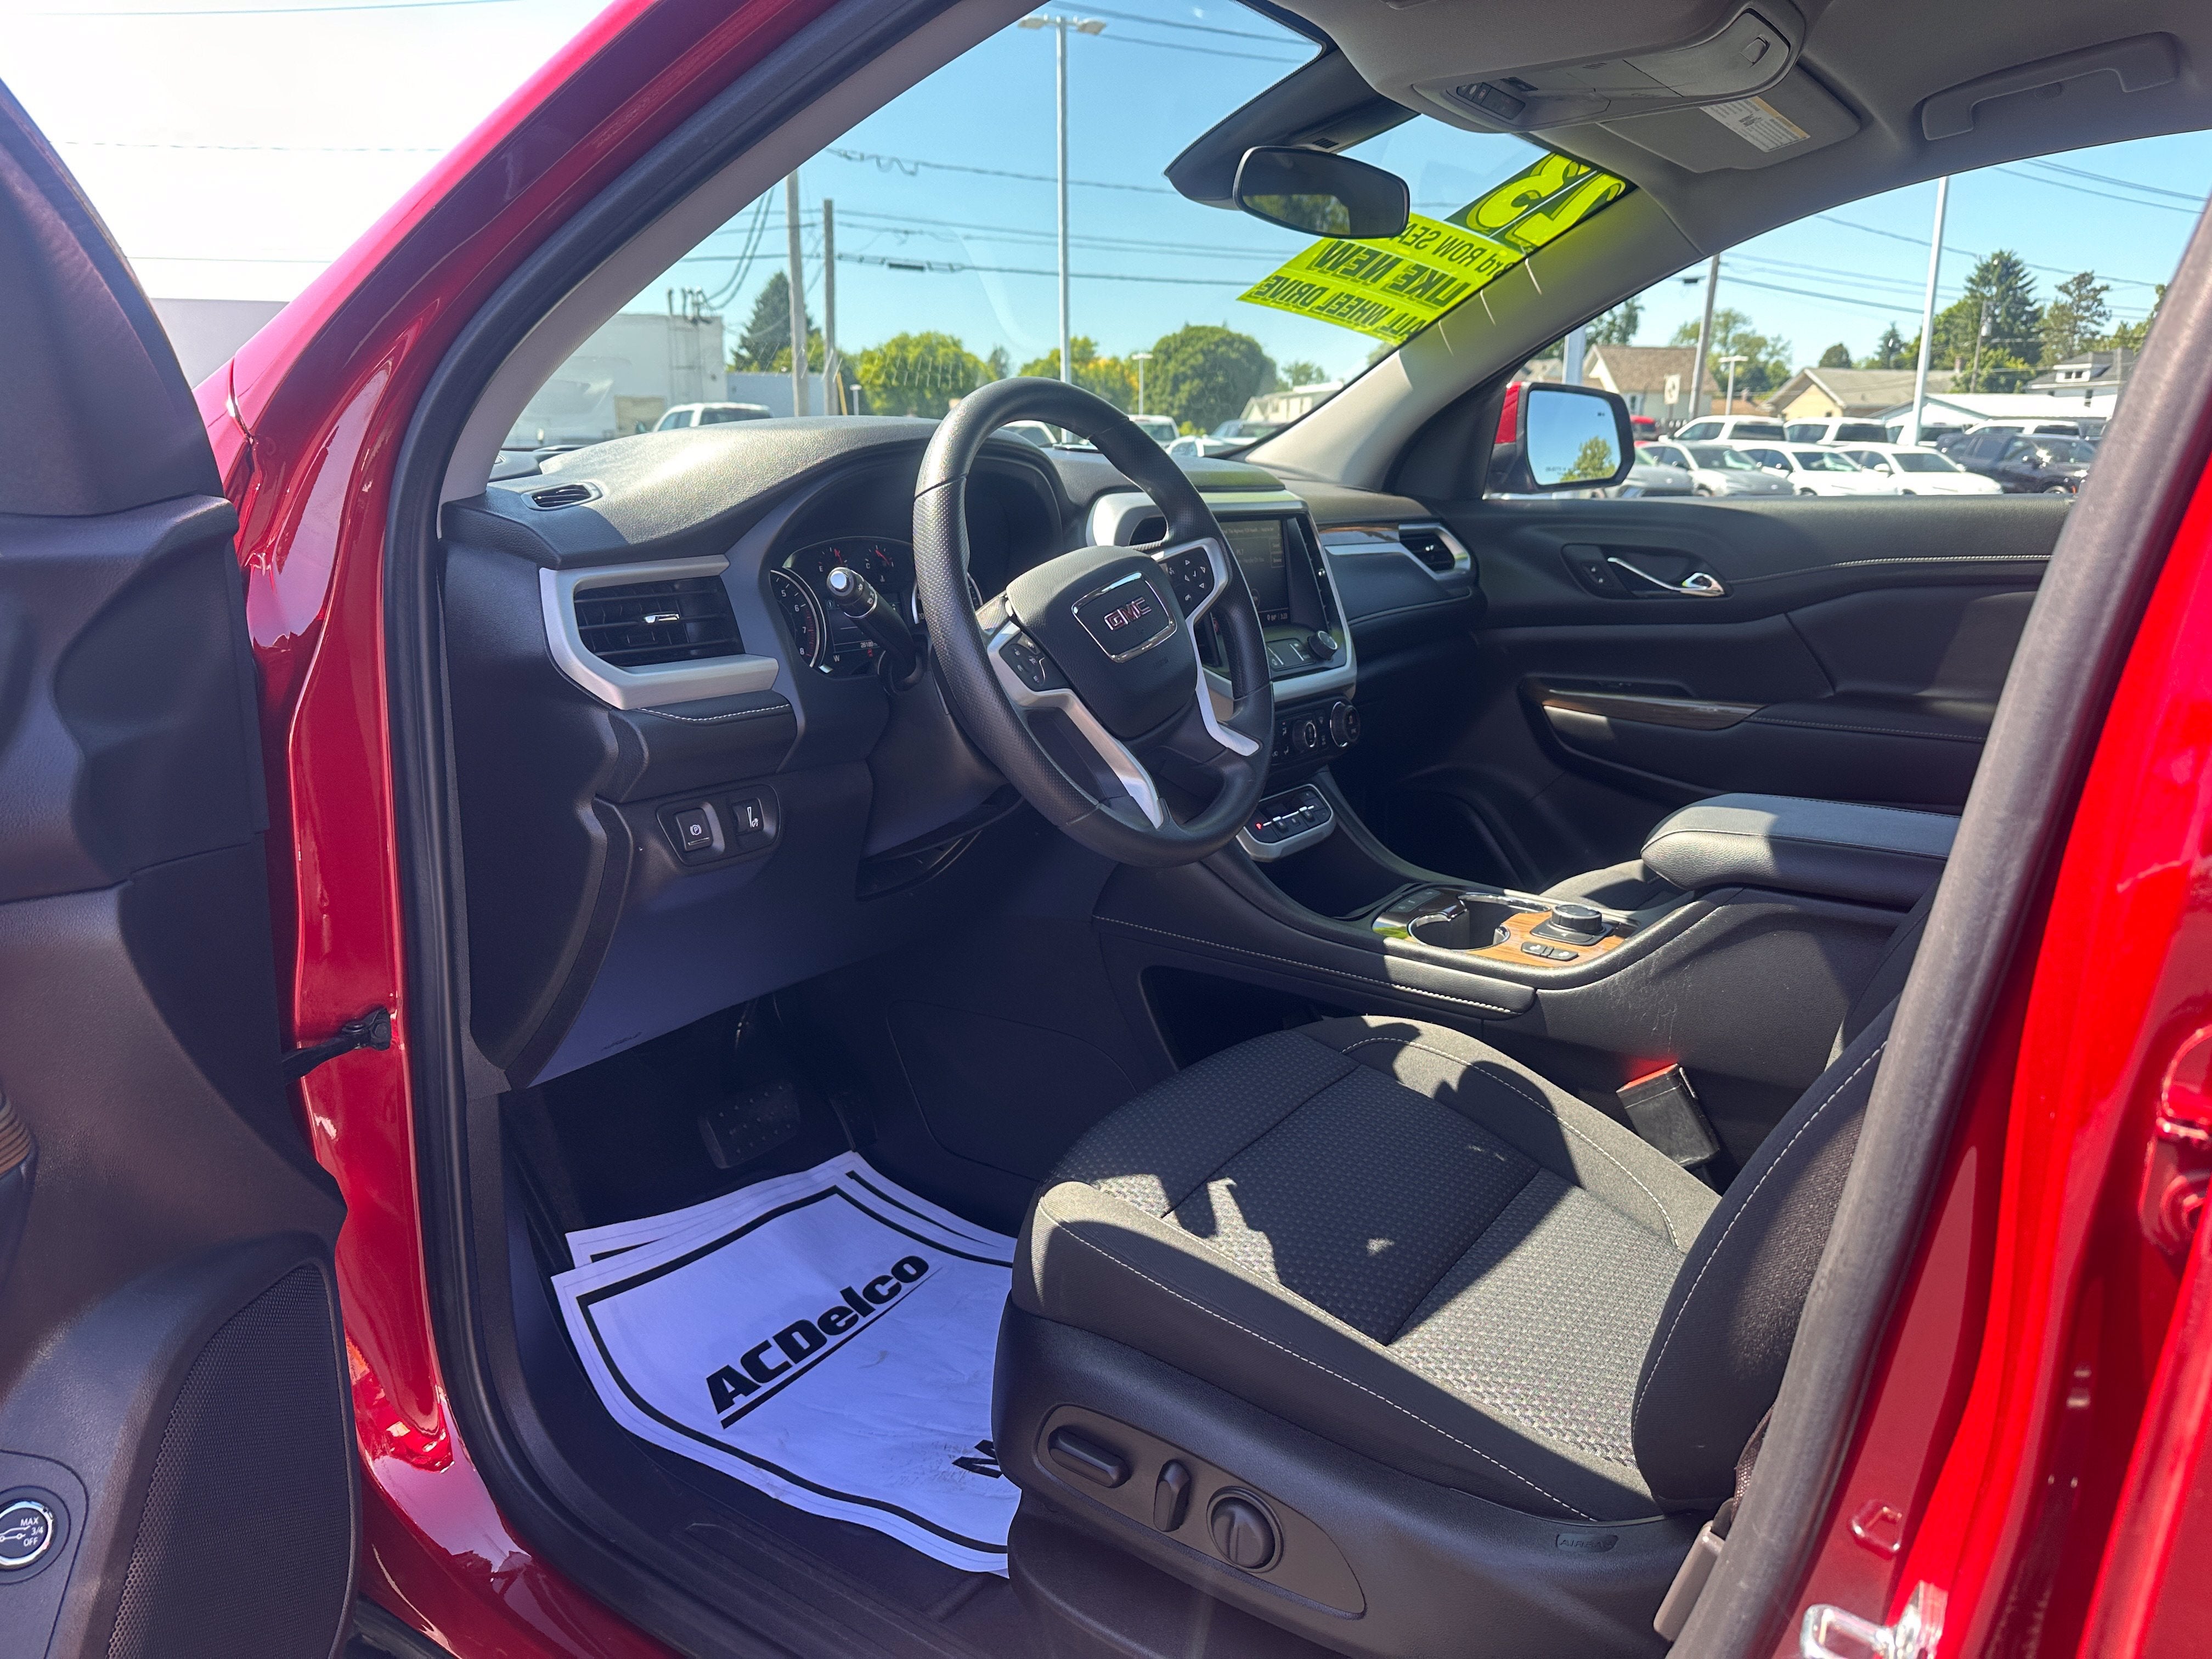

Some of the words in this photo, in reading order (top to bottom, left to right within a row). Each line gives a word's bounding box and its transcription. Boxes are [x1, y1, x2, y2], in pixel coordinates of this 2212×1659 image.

[781, 589, 787, 597] 5
[794, 604, 800, 612] 6
[1104, 596, 1152, 630] GMC
[802, 626, 807, 634] 7
[799, 647, 805, 656] 8
[706, 1255, 929, 1415] ACDelco
[20, 1516, 39, 1526] MAX
[30, 1526, 44, 1536] 3/4
[23, 1536, 38, 1547] OFF
